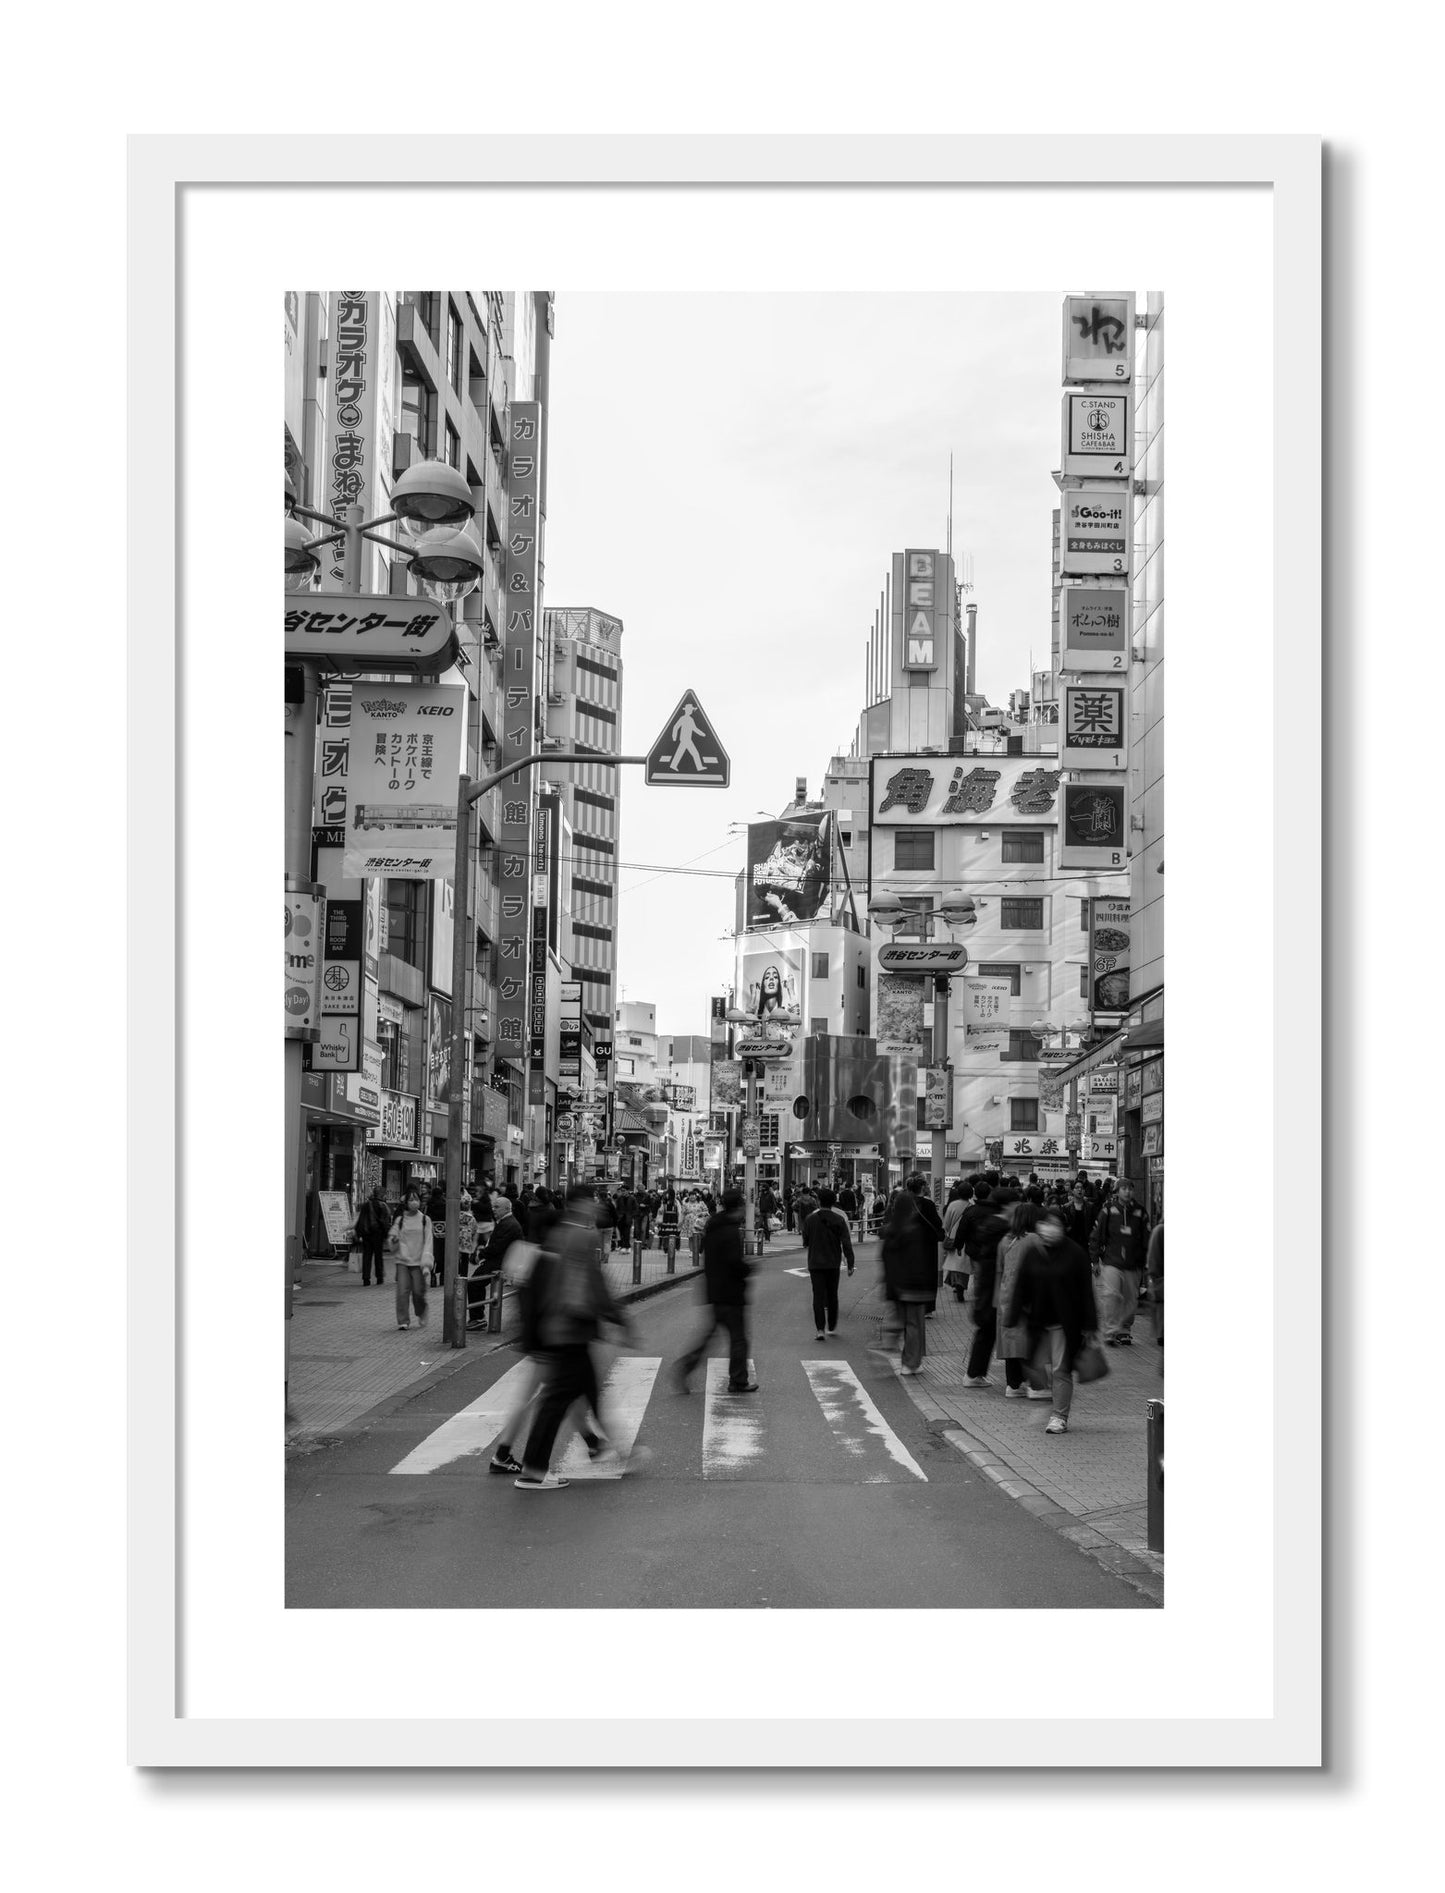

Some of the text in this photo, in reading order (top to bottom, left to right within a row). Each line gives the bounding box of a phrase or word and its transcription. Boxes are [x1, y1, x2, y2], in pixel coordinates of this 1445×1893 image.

[336, 300, 367, 404] カラオケ
[1115, 364, 1125, 376] 5
[1081, 401, 1116, 409] C.STAND
[1081, 432, 1116, 441] SHISHA
[1114, 461, 1123, 473] 4
[1071, 541, 1123, 550] 全身もみほぐし
[1113, 558, 1123, 571] 3
[909, 553, 934, 664] BEAM
[1113, 656, 1122, 668] 2
[417, 705, 454, 716] KEIO
[1074, 693, 1113, 732] 薬
[374, 733, 387, 766] 冒険へ
[388, 733, 402, 790] カントーの
[420, 734, 434, 780] 京王線で
[1112, 754, 1119, 767] 1
[878, 766, 1062, 814] 角海老
[1112, 852, 1121, 865] B
[499, 855, 526, 1041] カラオケ館
[883, 950, 963, 960] 渋谷センター街
[1094, 956, 1116, 972] 6F
[320, 1044, 346, 1053] Whisky
[596, 1046, 611, 1055] GU
